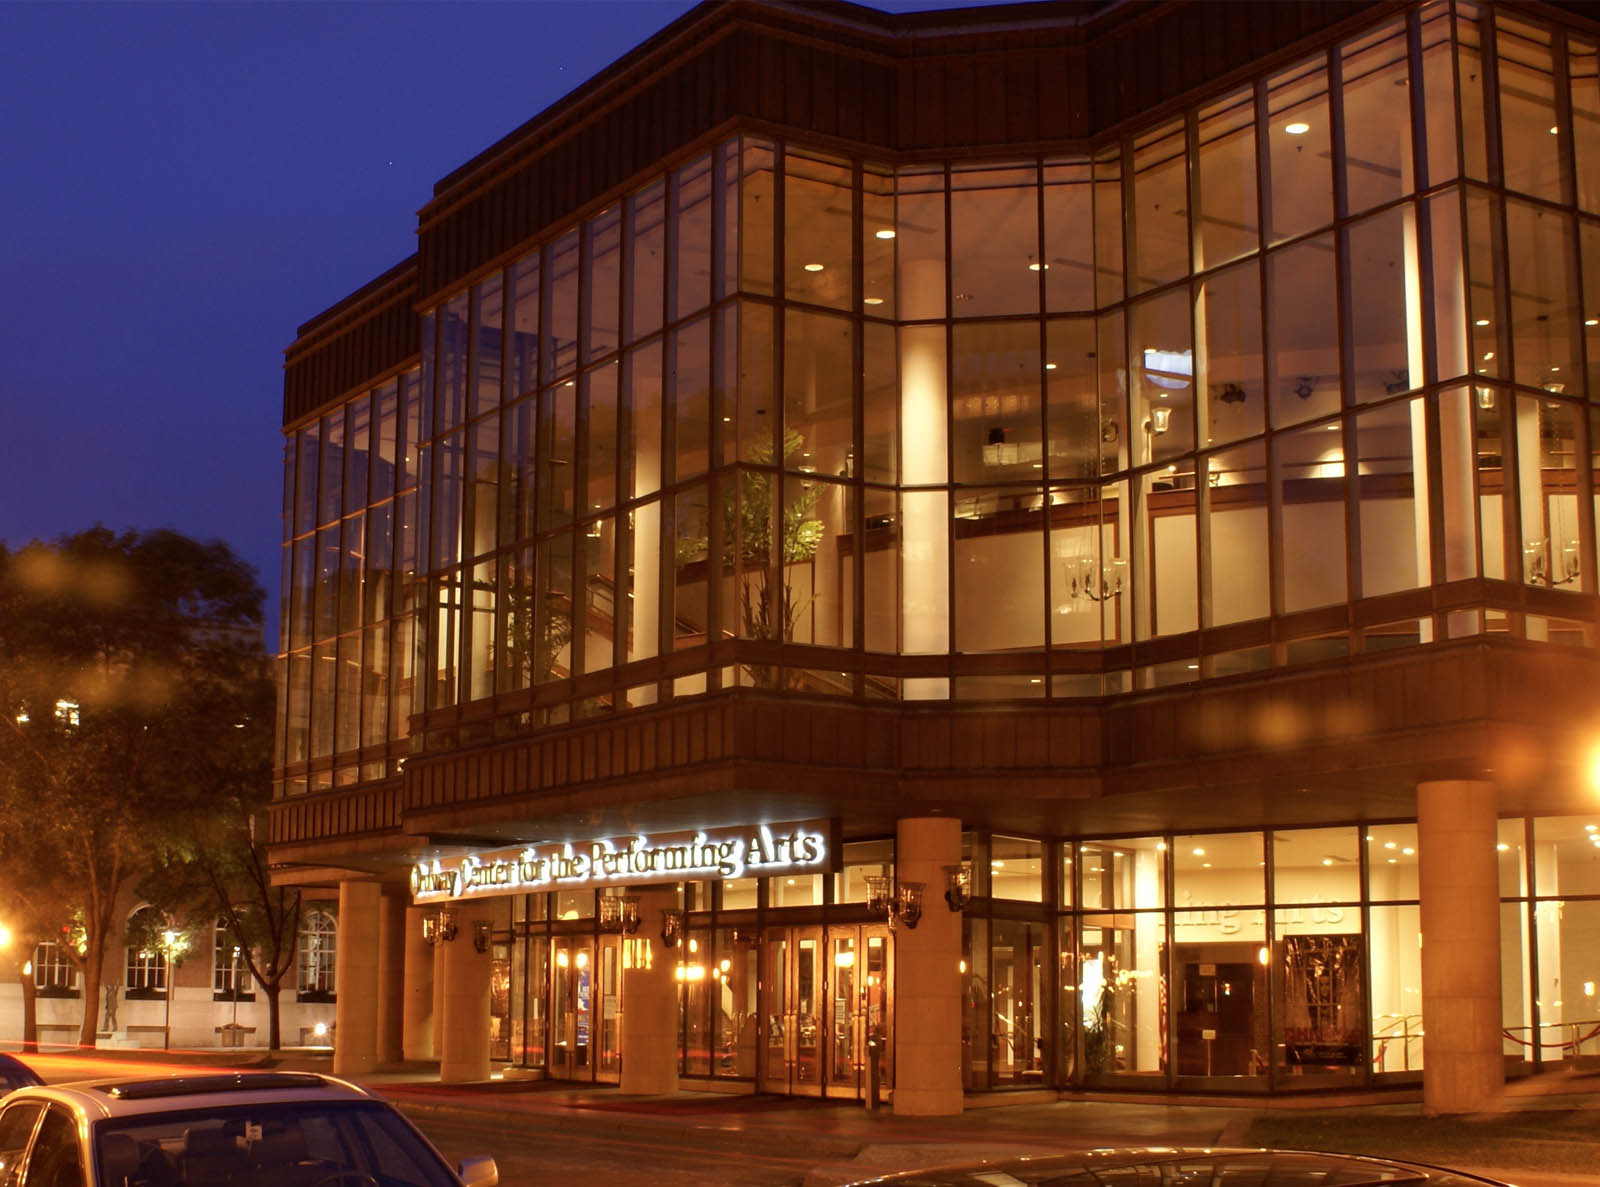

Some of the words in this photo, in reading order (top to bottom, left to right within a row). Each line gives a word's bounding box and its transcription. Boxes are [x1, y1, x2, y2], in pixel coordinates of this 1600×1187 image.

[461, 856, 517, 889] Center
[519, 848, 548, 883] for
[551, 845, 587, 881] the
[591, 831, 741, 877] Performing
[745, 825, 822, 866] Arts
